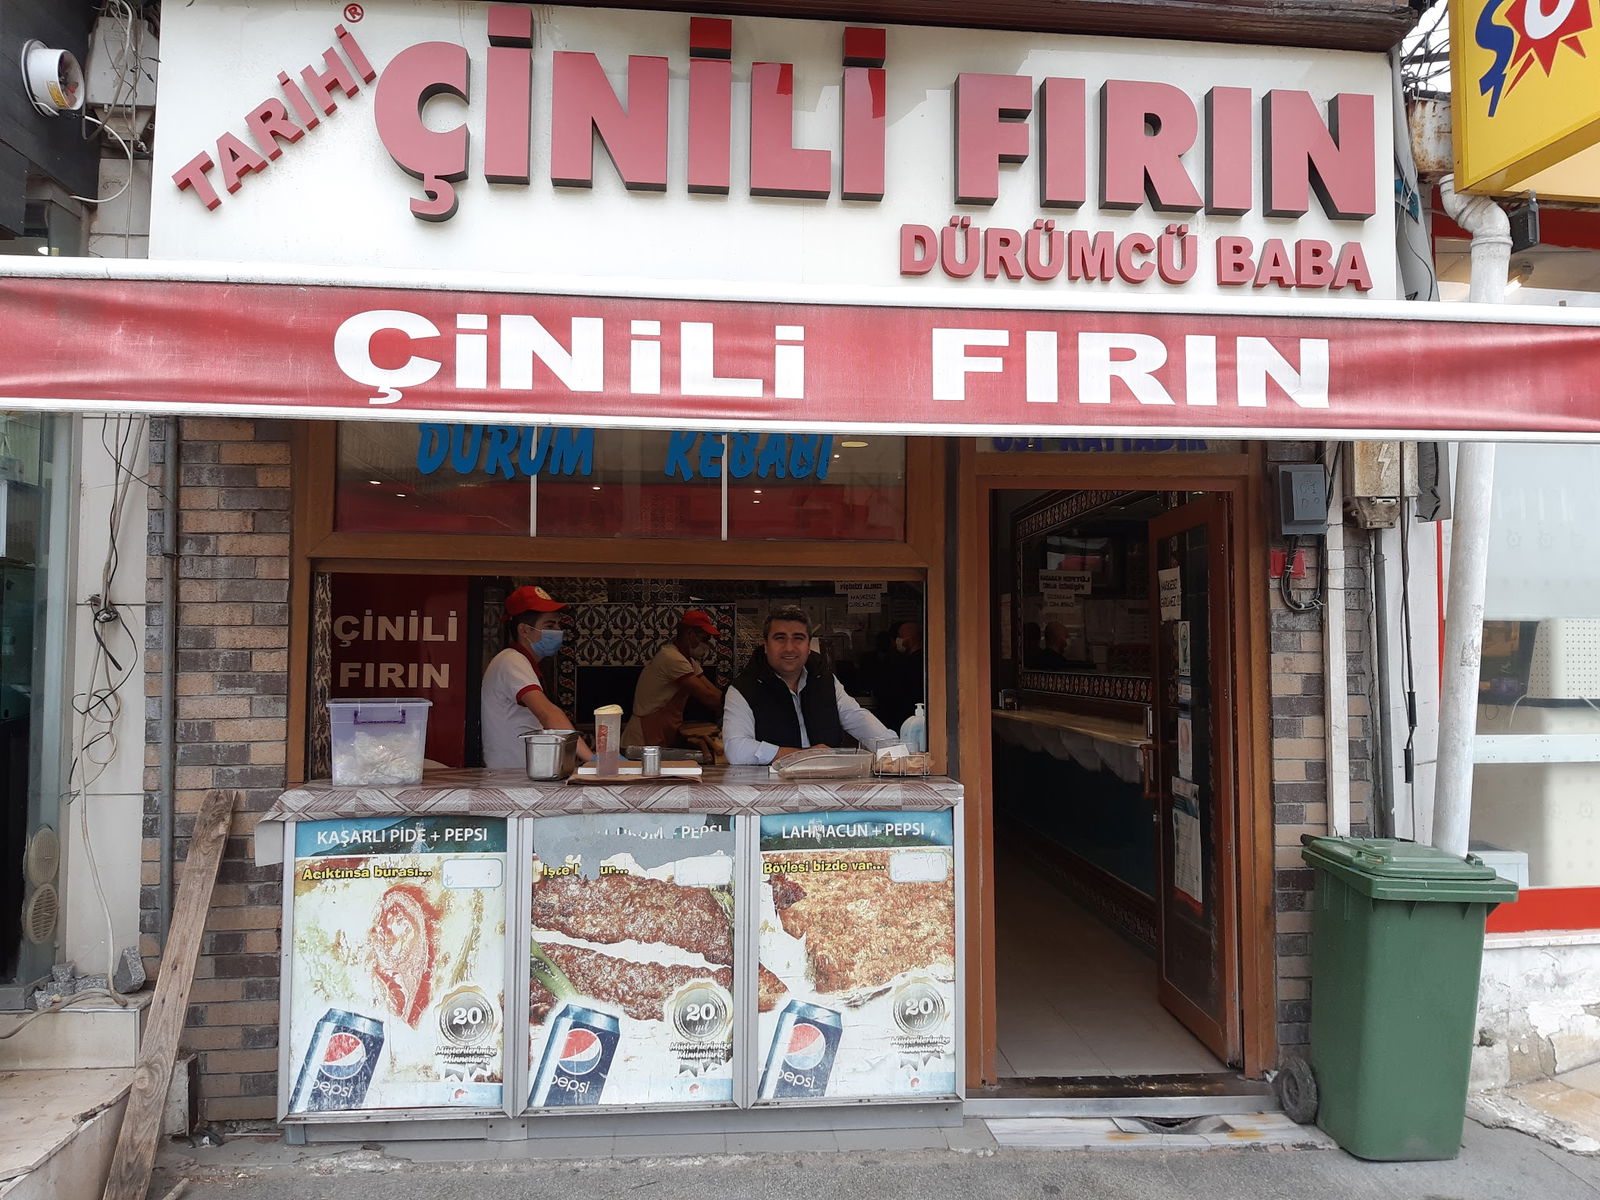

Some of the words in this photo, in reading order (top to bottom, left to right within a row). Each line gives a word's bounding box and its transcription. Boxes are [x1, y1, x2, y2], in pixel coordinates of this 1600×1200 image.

[172, 24, 376, 211] TARİHİ
[374, 5, 886, 222] ÇİNİLİ
[954, 73, 1376, 220] FIRIN
[900, 216, 1197, 284] DÜRÜMCÜ
[1216, 236, 1373, 291] BABA
[932, 328, 1330, 409] FIRIN
[339, 662, 450, 688] FIRIN
[317, 827, 386, 847] KAŞARLI
[390, 826, 427, 843] PİDE
[445, 828, 488, 842] PEPSI
[885, 822, 925, 836] PEPSI
[813, 860, 848, 872] bizde
